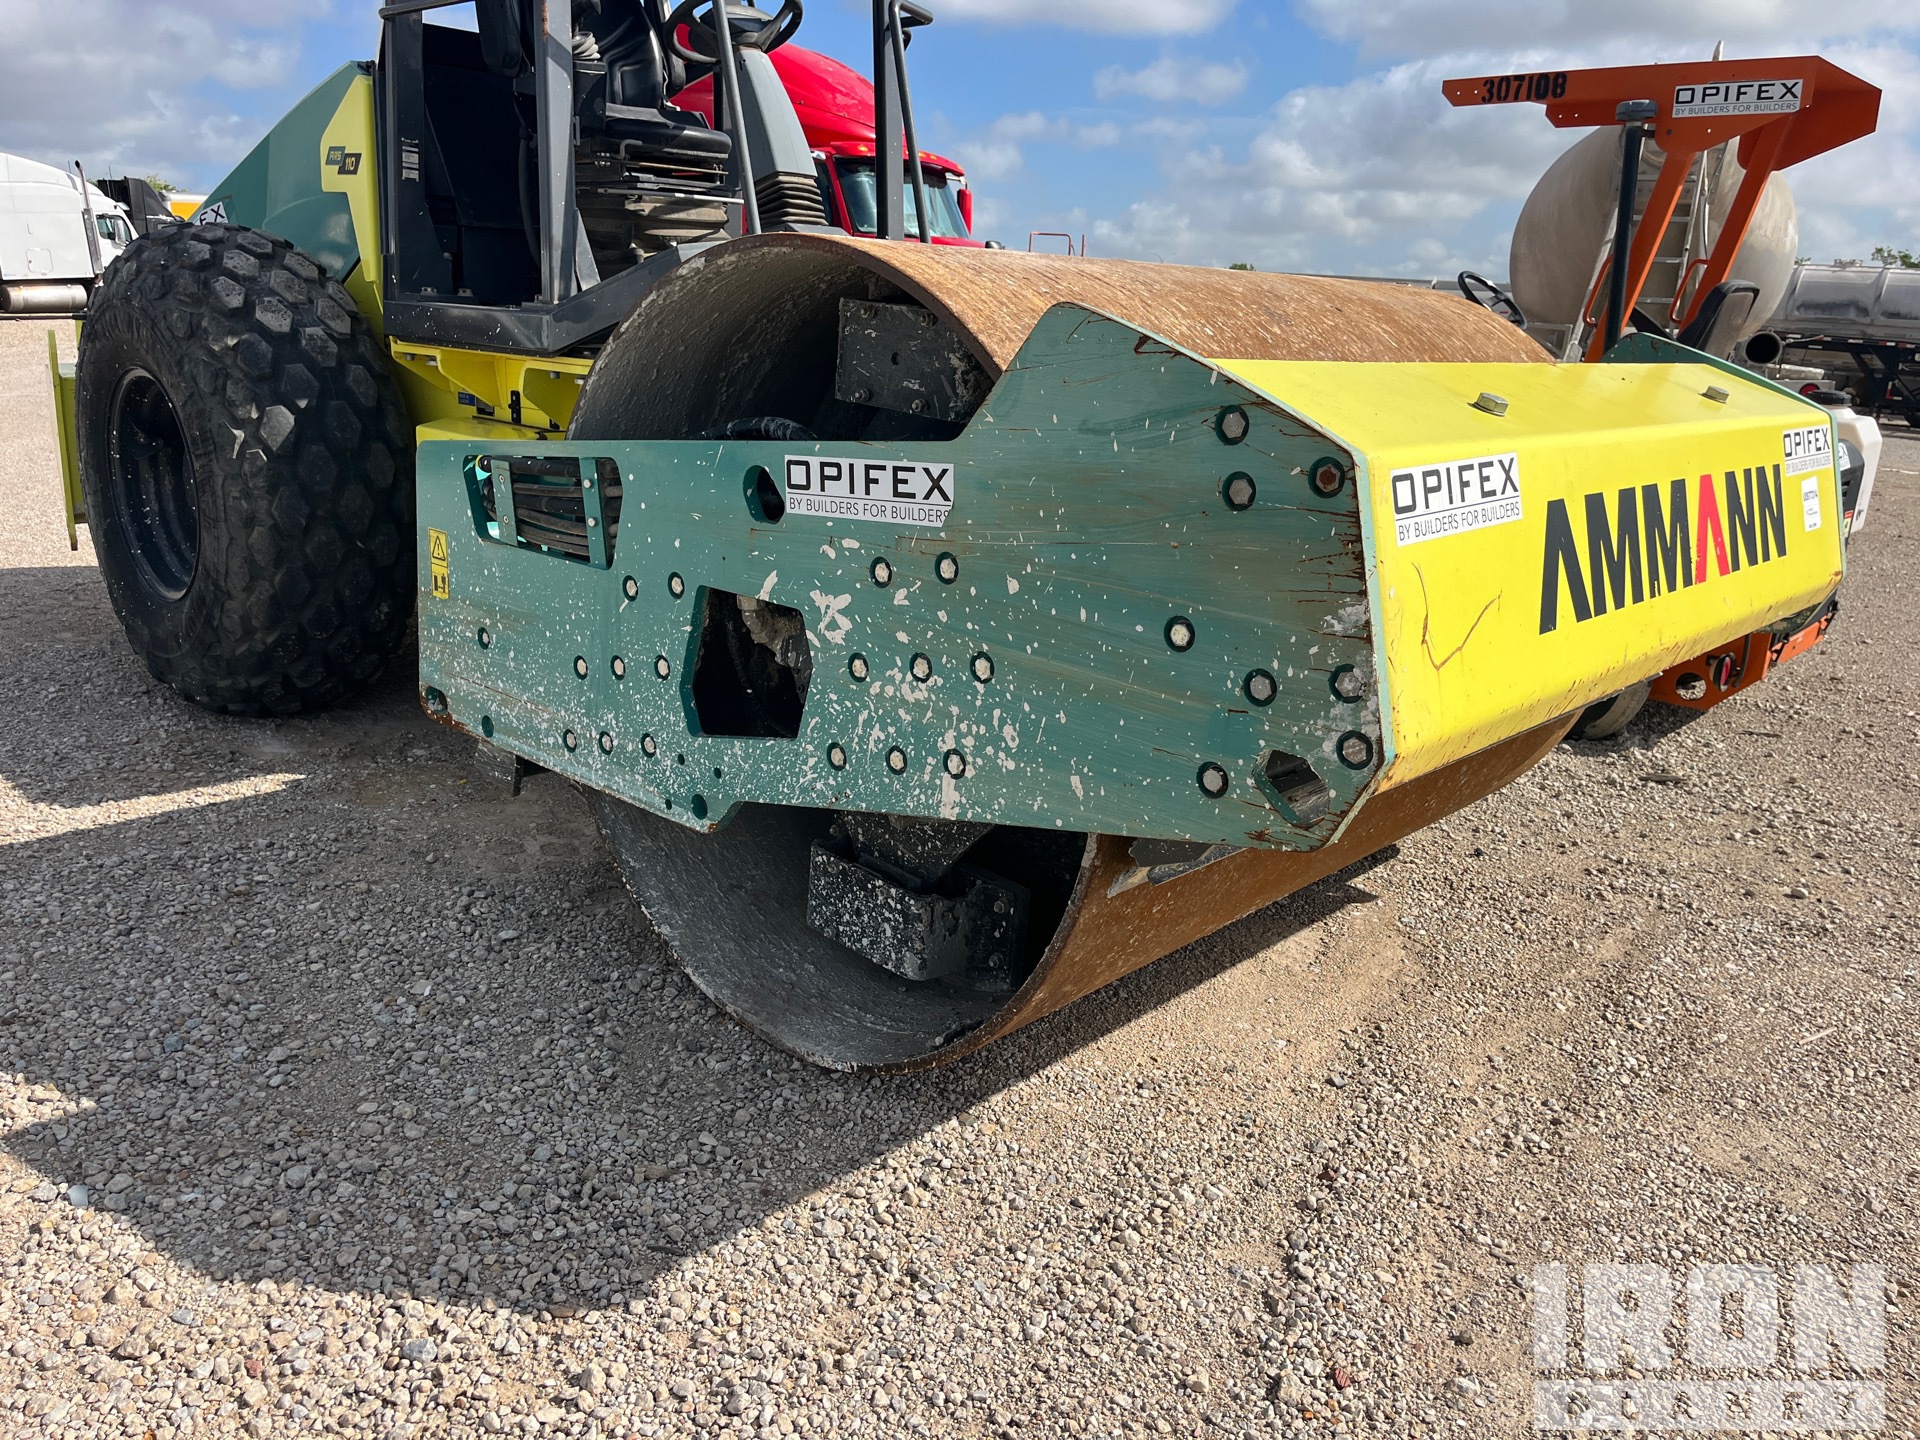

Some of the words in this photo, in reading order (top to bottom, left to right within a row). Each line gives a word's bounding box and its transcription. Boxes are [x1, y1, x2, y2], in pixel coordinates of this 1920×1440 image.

[1481, 72, 1567, 103] 307108
[1675, 82, 1799, 104] OPIFEX
[1675, 107, 1686, 115] BY
[1688, 105, 1730, 115] BUILDERS
[1733, 104, 1751, 113] FOR
[1754, 102, 1797, 112] BUILDERS
[1784, 428, 1830, 458] OPIFEX
[786, 459, 952, 502] OPIFEX
[1391, 457, 1519, 515] OPIFEX
[789, 497, 802, 510] BY
[806, 500, 859, 516] BUILDERS
[863, 503, 887, 518] FOR
[1398, 523, 1411, 541] BY
[1414, 513, 1459, 537] BUILDERS
[1461, 509, 1480, 527] FOR
[1481, 501, 1520, 523] BUILDERS
[1539, 463, 1787, 635] AMMANN
